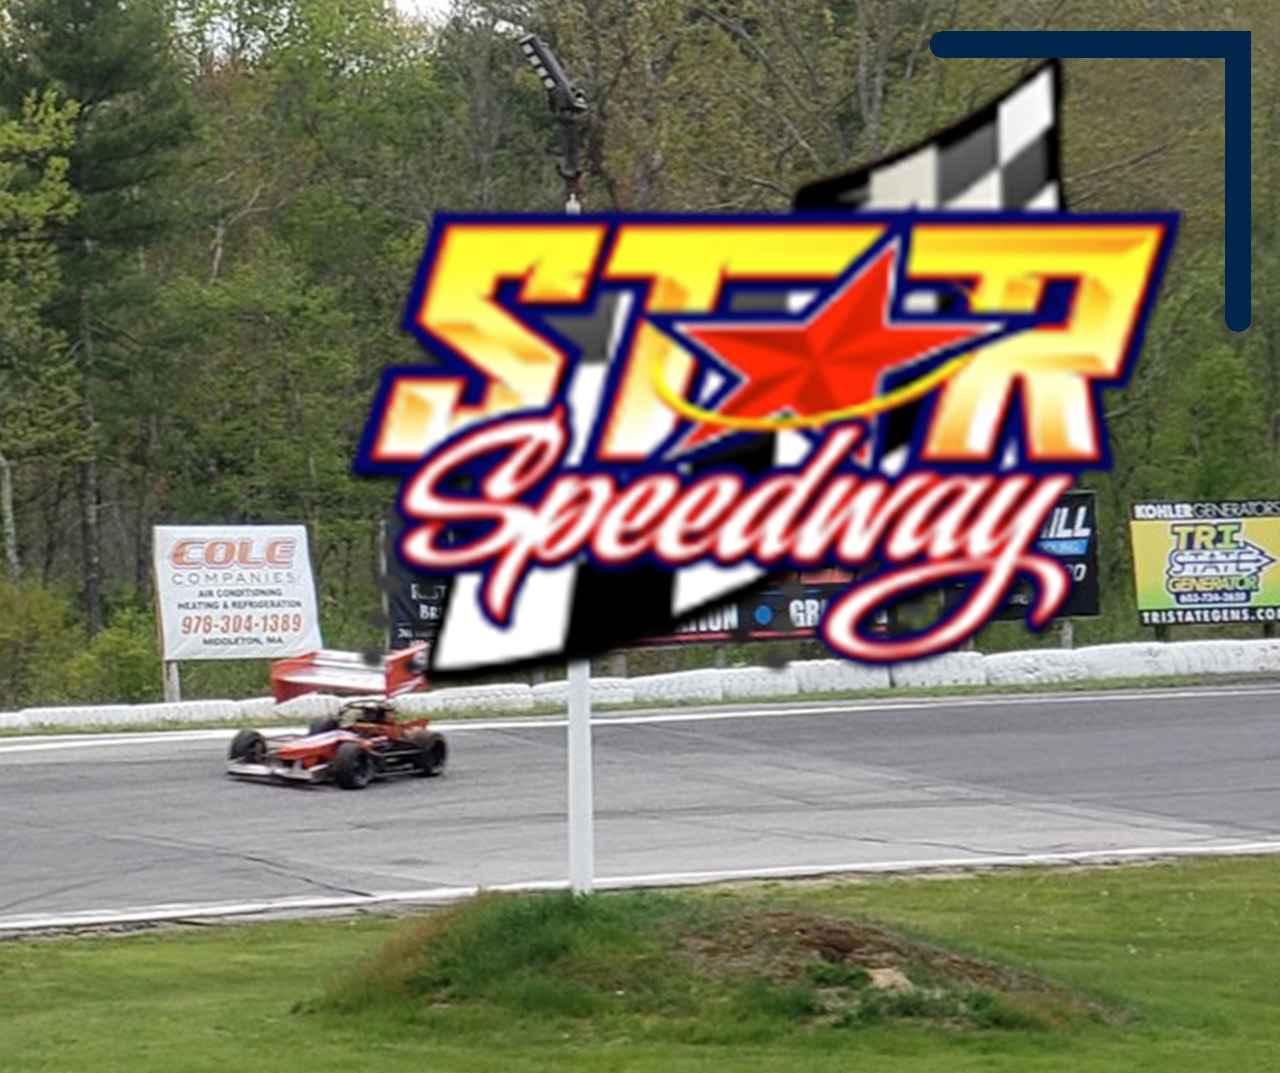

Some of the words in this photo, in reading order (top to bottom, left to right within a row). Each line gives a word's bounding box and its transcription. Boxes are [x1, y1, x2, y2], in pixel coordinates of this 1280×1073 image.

[1172, 522, 1241, 549] TRI
[171, 537, 297, 569] COLE
[1167, 549, 1262, 577] STATE
[171, 572, 297, 586] COMPANIES
[1166, 575, 1259, 593] GENERATOR
[198, 589, 214, 598] AIR
[217, 588, 283, 598] CONDITIONING
[177, 601, 219, 610] HEATING
[232, 600, 302, 610] REFRIGERATION
[181, 614, 303, 635] 978-304-1389
